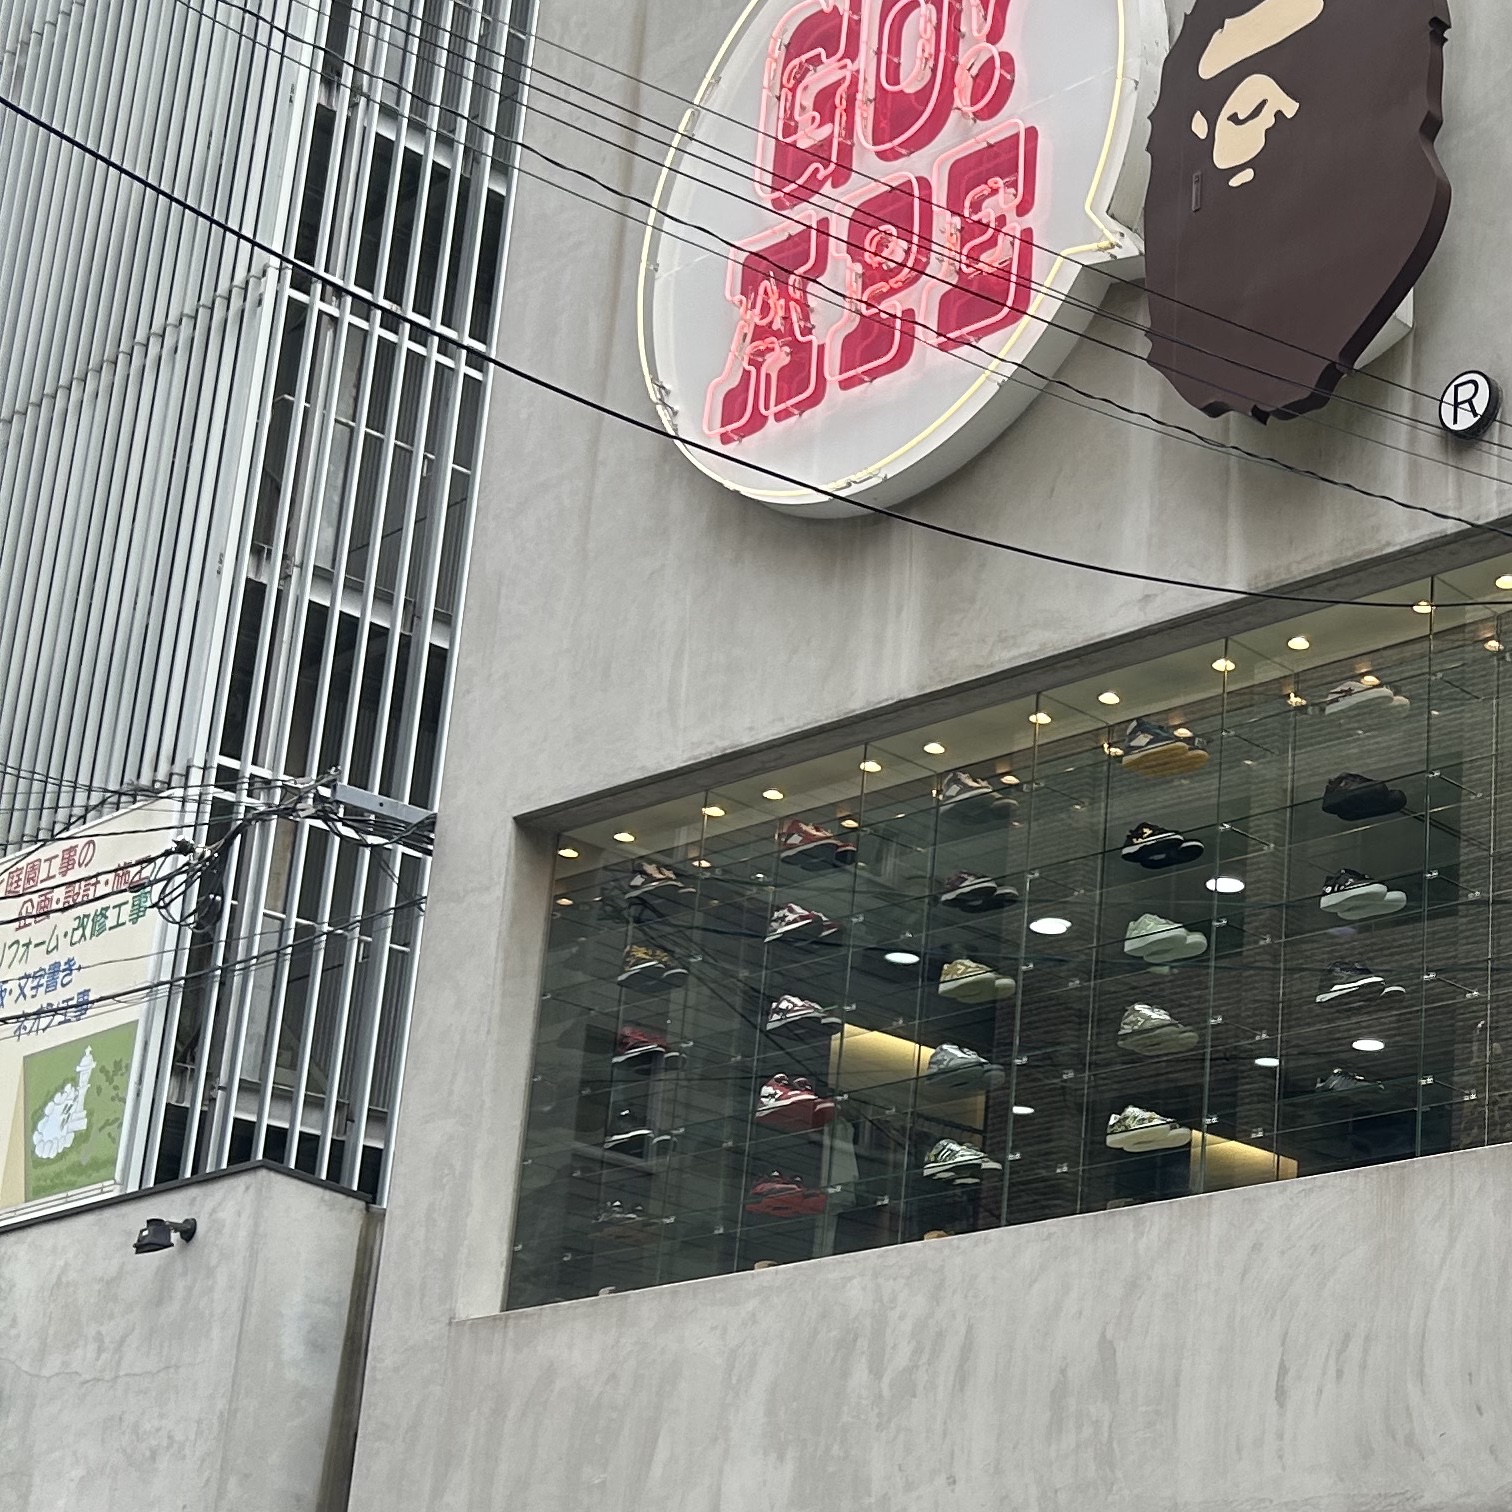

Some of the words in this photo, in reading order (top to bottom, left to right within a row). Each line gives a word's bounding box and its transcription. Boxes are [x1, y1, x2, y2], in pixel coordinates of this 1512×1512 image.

[703, 118, 1039, 446] APE
[0, 839, 96, 896] 庭園工事の
